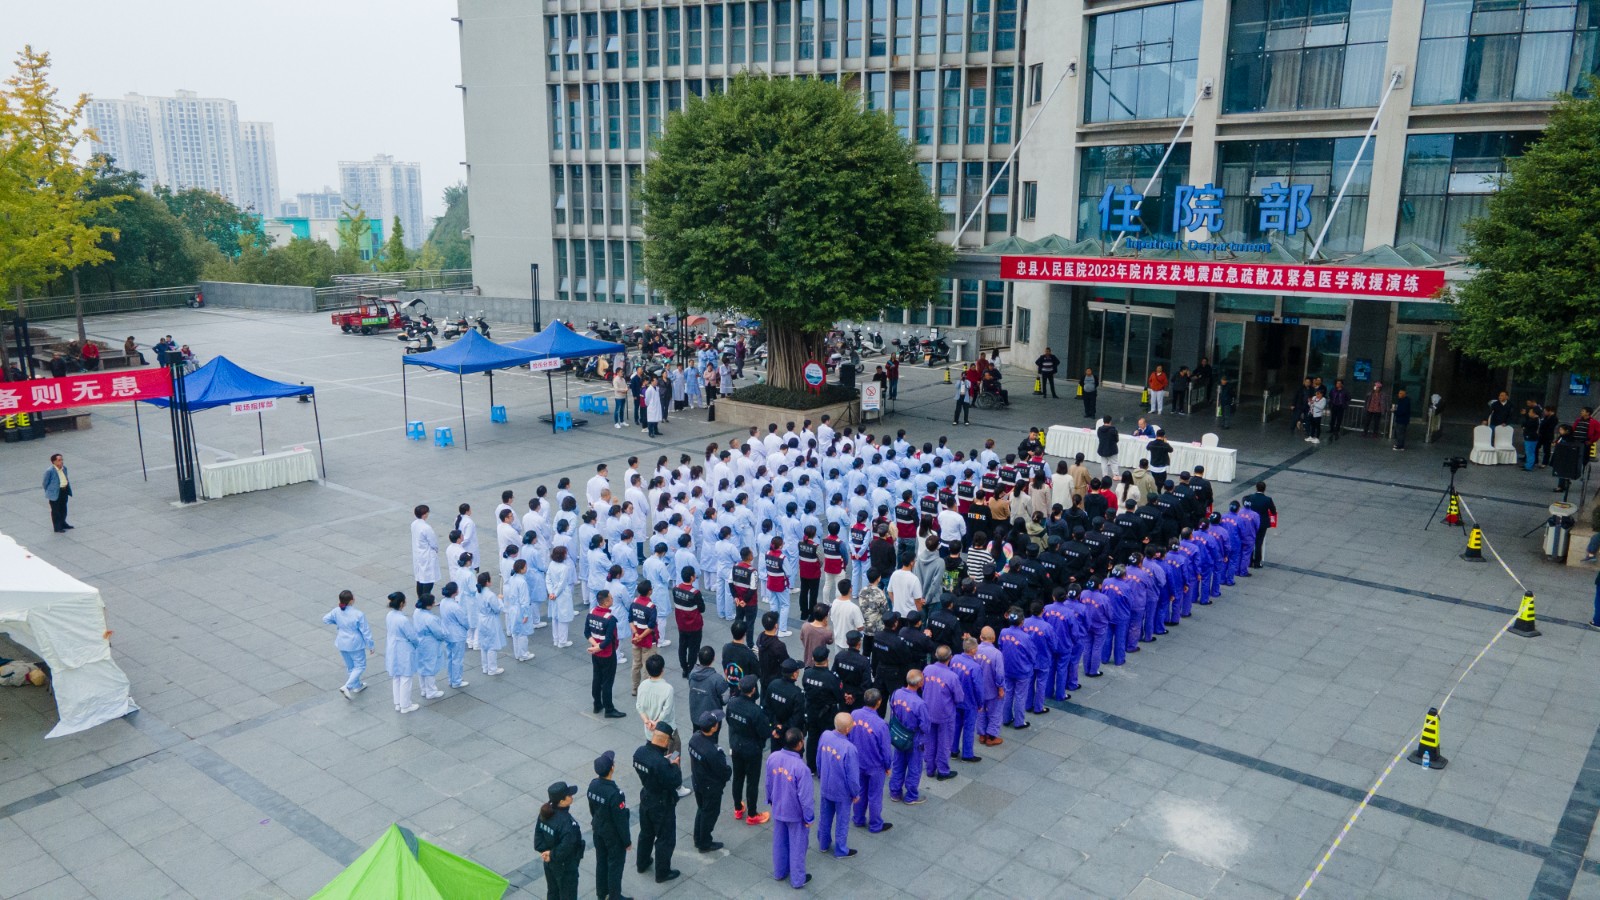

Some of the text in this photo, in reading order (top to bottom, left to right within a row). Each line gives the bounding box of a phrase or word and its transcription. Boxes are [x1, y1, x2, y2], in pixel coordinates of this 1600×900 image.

[1098, 182, 1314, 236] 住院部
[1125, 237, 1272, 254] Inpatient Department
[1016, 260, 1420, 293] 忠县人民医院2023年院内突发地震应急疏散及紧急医学救援演练
[235, 400, 274, 413] 现场指挥部
